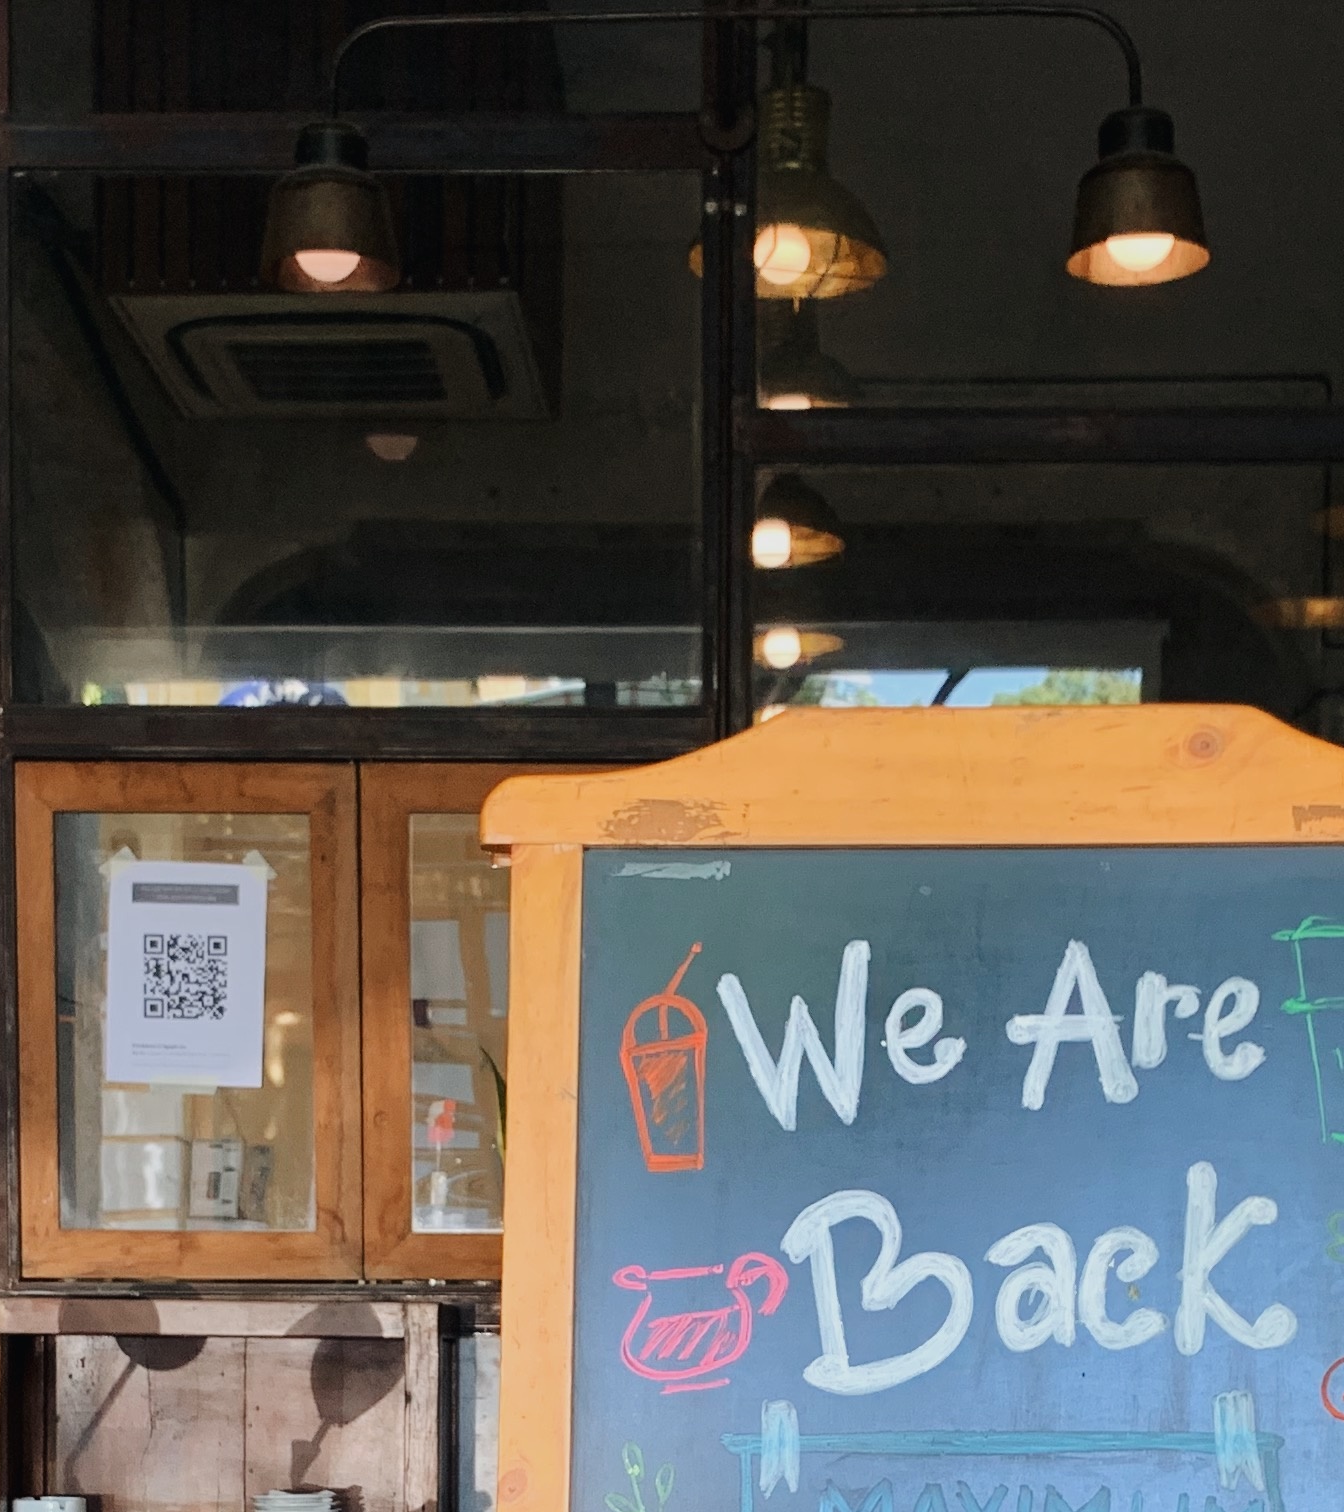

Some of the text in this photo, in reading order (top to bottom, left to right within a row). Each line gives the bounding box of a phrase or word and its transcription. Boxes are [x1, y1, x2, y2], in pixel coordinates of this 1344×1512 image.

[716, 938, 1266, 1131] We Are
[779, 1160, 1298, 1395] Back
